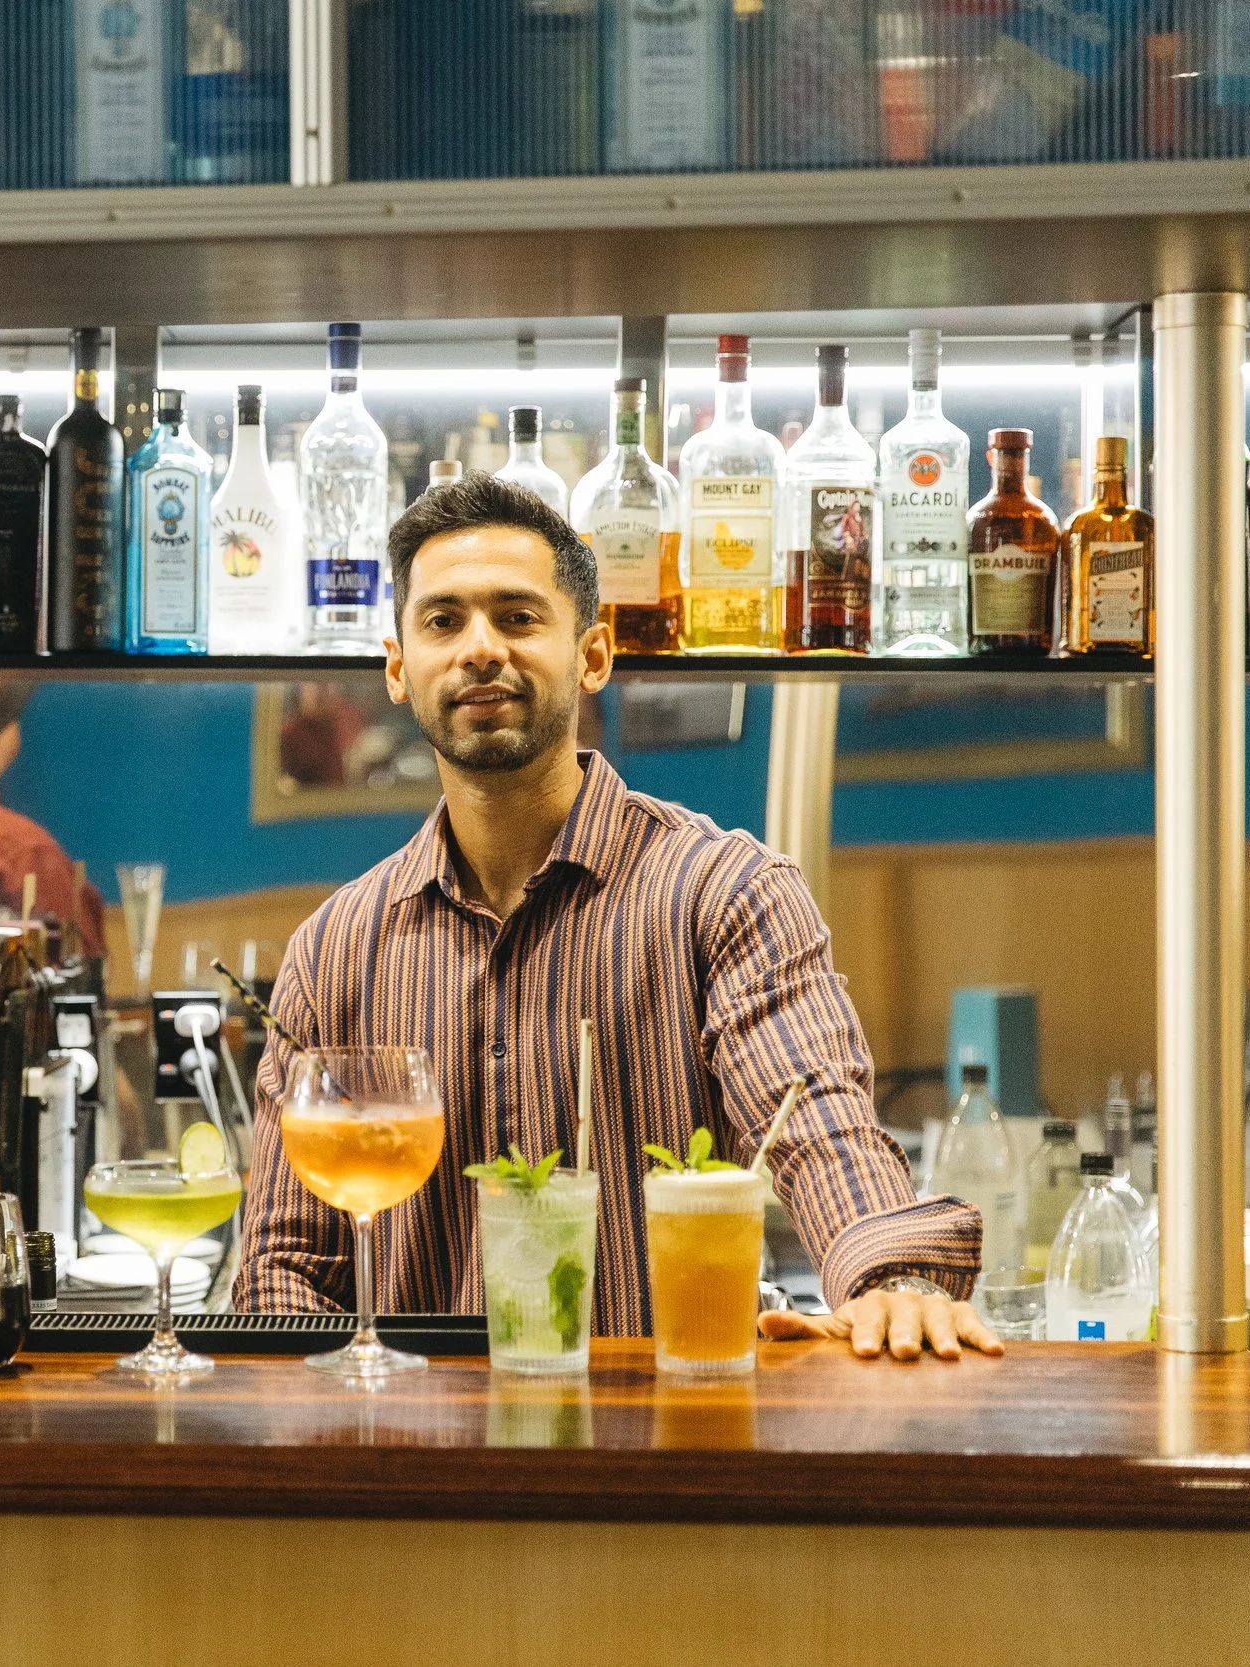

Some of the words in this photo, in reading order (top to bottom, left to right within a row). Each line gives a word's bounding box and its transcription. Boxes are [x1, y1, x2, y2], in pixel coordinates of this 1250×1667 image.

[703, 484, 738, 496] MOUNT
[741, 484, 762, 496] GAY
[974, 557, 1047, 571] DRAMBUIE
